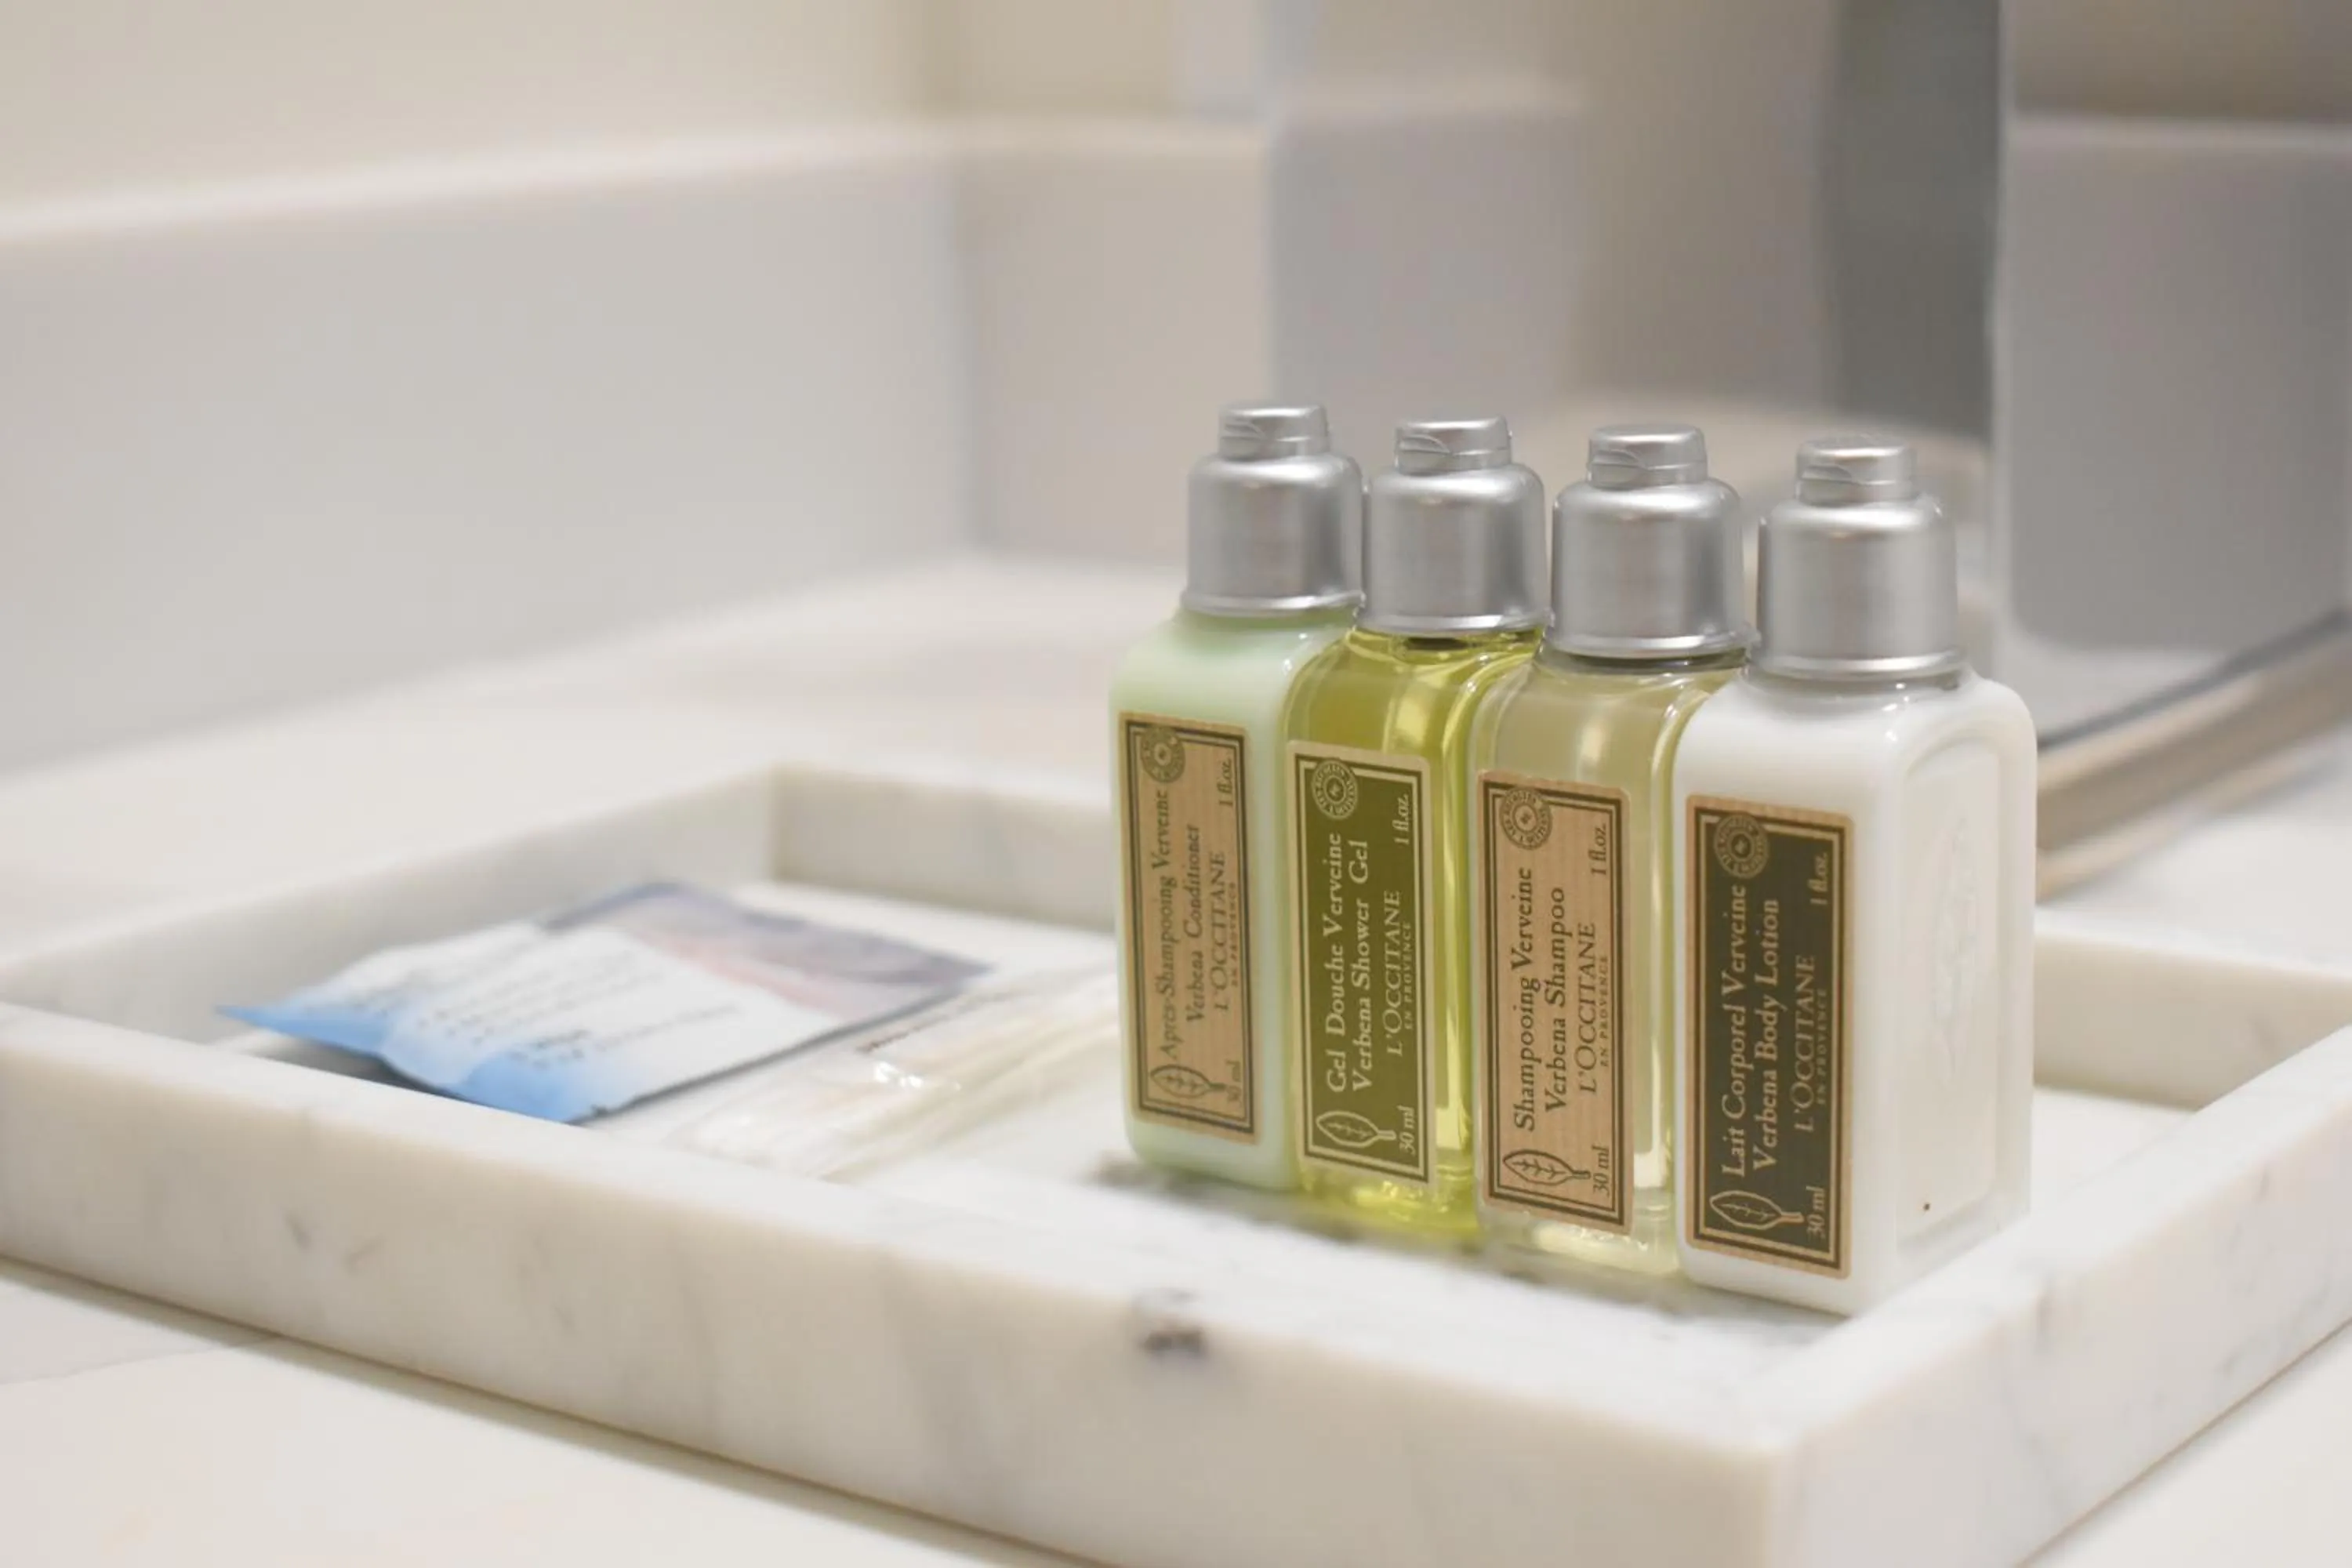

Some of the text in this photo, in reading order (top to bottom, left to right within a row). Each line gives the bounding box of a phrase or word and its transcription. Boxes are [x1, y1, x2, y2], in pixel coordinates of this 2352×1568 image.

[1323, 833, 1343, 937] Verveine
[1394, 836, 1410, 845] 1
[1590, 867, 1606, 876] 1
[1183, 824, 1205, 1022] Verbena Conditioner
[1210, 851, 1229, 1011] L'OCCITANE
[1348, 839, 1372, 1091] Verbena Shower Gel
[1382, 890, 1403, 1057] L'OCCITANE
[1510, 867, 1533, 971] Verveine
[1721, 884, 1746, 996] Verveine
[1324, 944, 1346, 1036] Douche
[1402, 922, 1413, 1030] EN PROVENCE
[1544, 887, 1573, 1113] Verbena Shampoo
[1574, 922, 1597, 1094] L'OCCITANE
[1597, 956, 1609, 1067] EN PROVENCE
[1326, 1049, 1347, 1092] Gel
[1512, 977, 1541, 1132] Shampooing
[1721, 1003, 1754, 1120] Corporel
[1752, 898, 1788, 1171] Verbena Body Lotion
[1789, 955, 1815, 1132] L'OCCITANE
[1817, 989, 1828, 1105] EN PROVENCE
[1396, 1105, 1416, 1156] 30 ml
[1592, 1145, 1610, 1196] 30 ml
[1722, 1126, 1745, 1177] Lait
[1806, 1185, 1826, 1240] 30 ml
